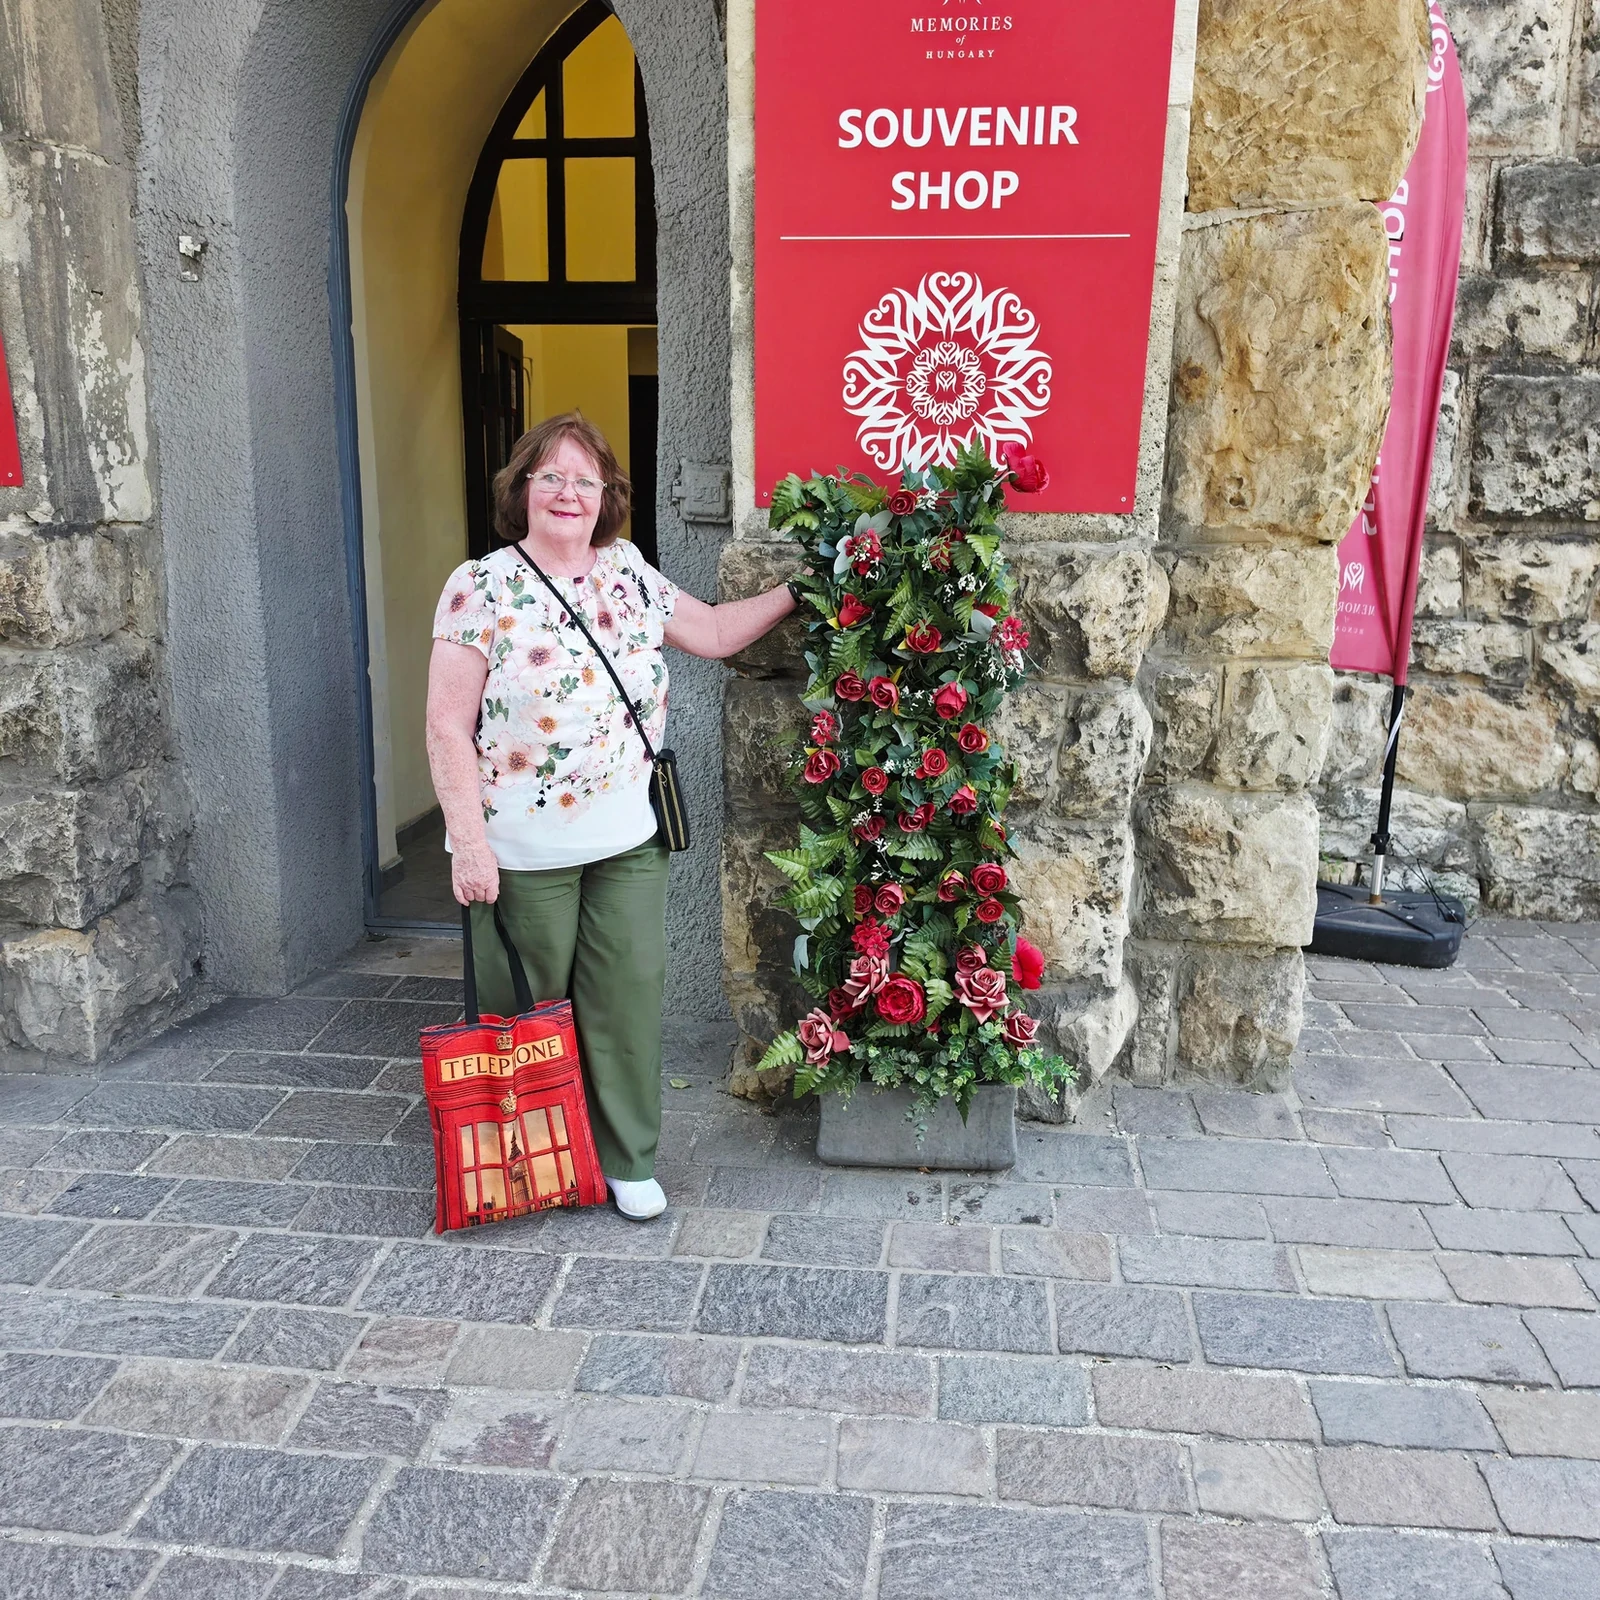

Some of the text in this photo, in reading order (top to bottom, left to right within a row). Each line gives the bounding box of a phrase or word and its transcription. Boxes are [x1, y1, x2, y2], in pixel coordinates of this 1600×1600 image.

[910, 16, 1013, 32] MEMORIES
[955, 35, 967, 46] of
[926, 49, 995, 59] HUNGARY
[838, 105, 1080, 149] SOUVENIR
[891, 170, 1020, 211] SHOP
